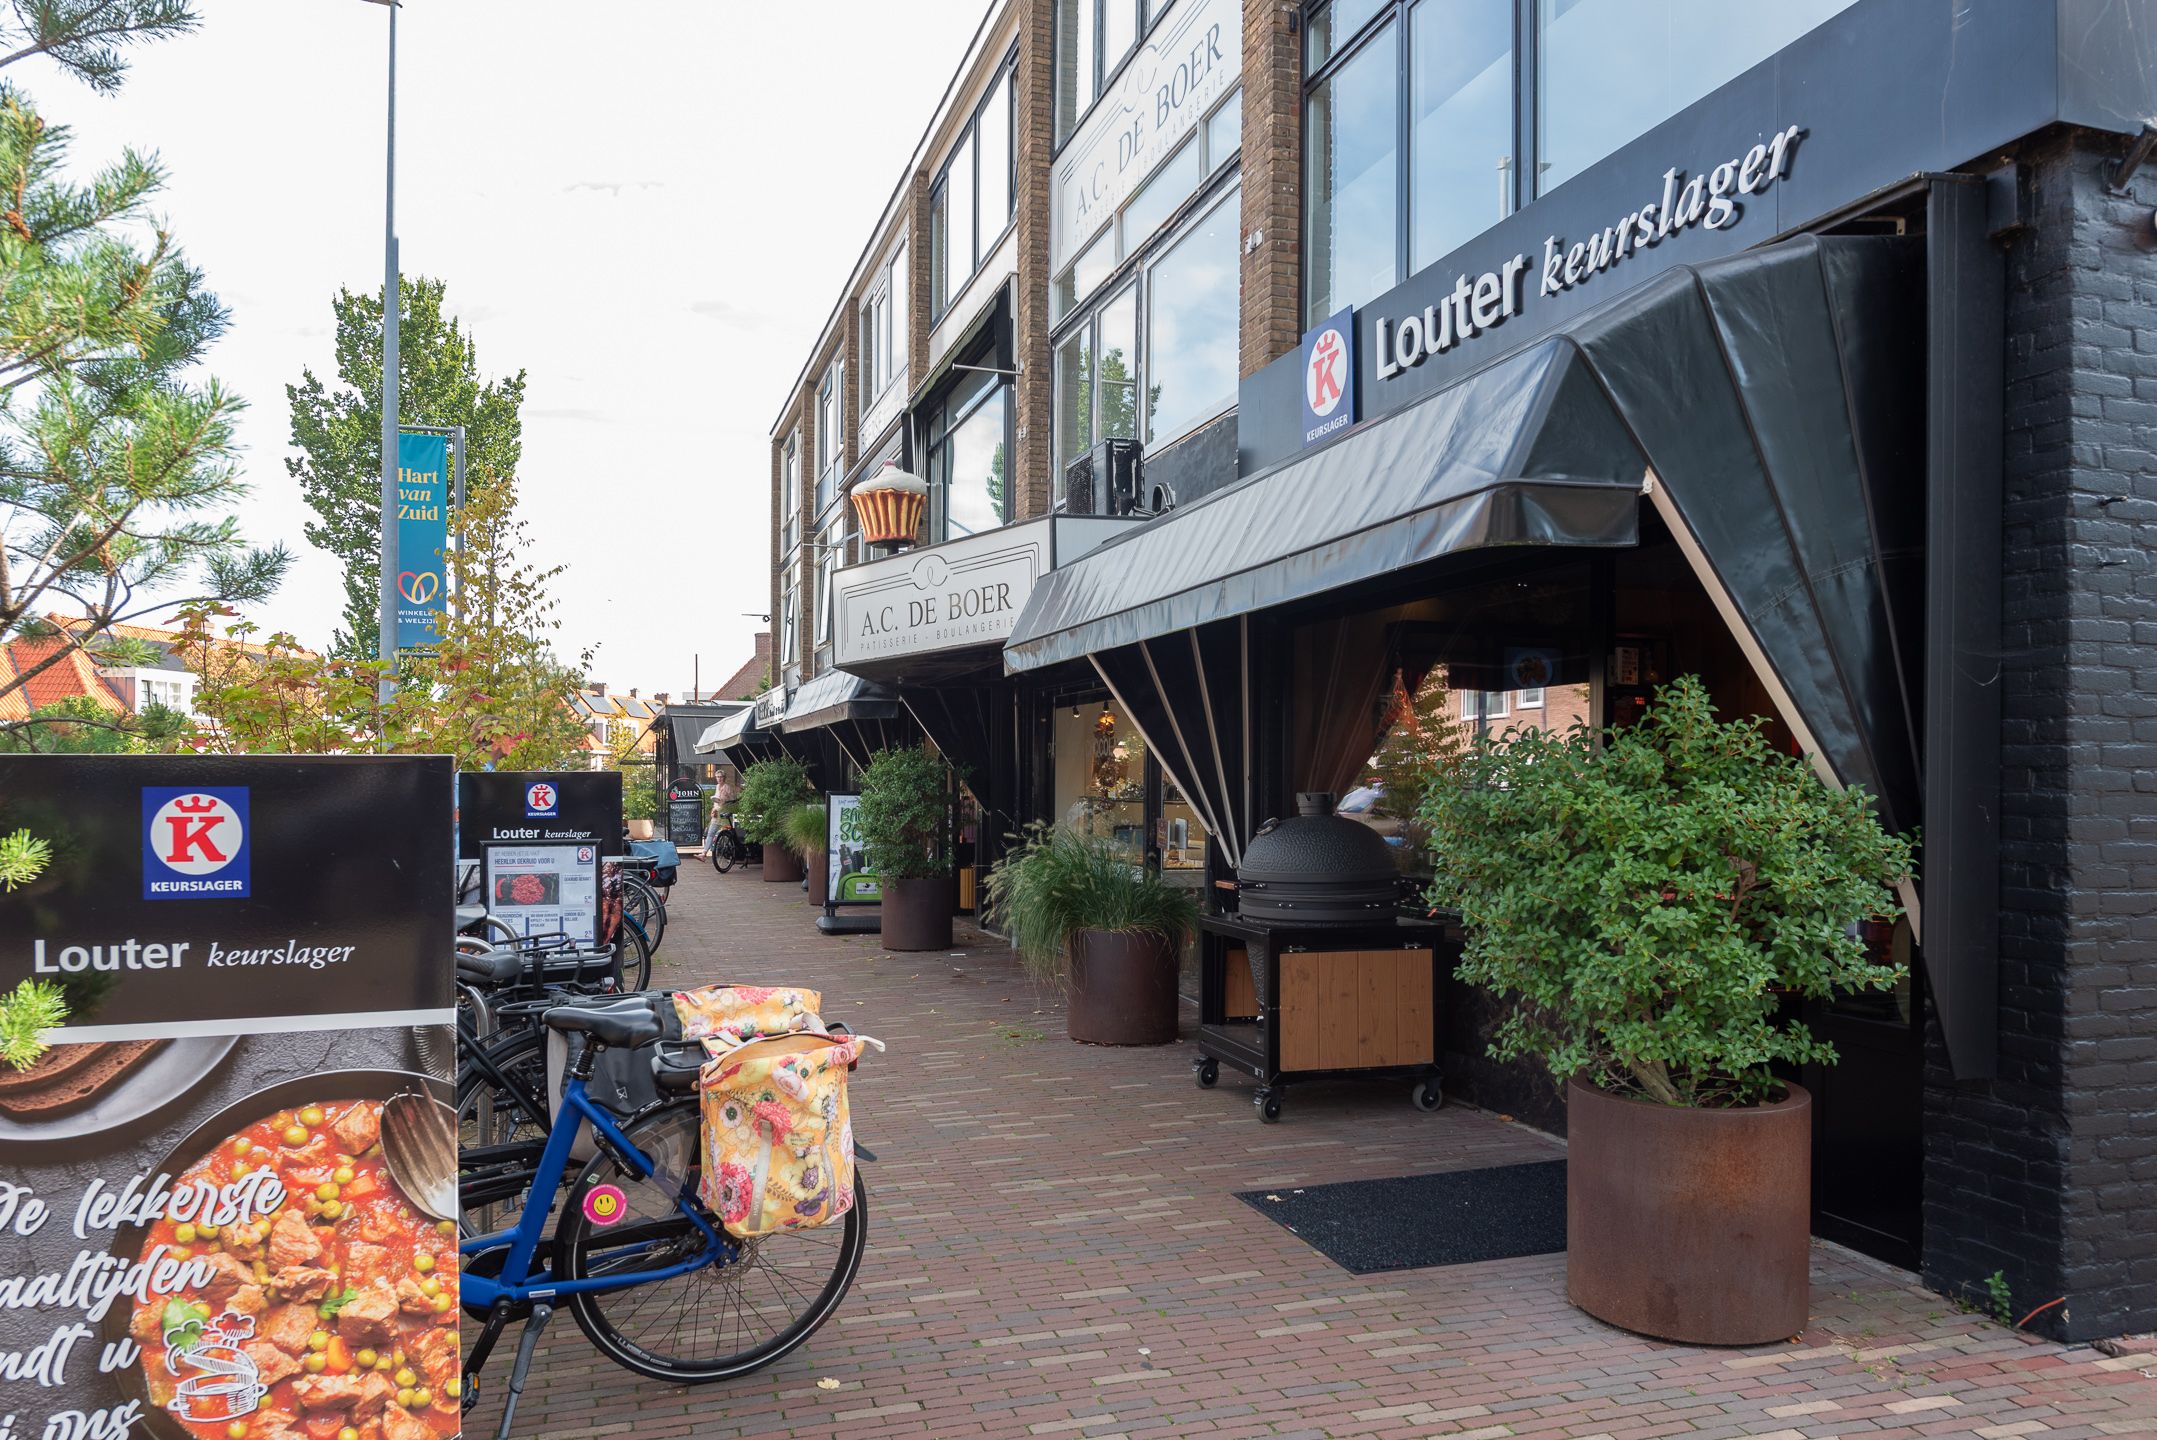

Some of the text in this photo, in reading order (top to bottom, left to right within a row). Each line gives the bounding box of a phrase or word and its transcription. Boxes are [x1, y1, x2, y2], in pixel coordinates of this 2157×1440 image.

[1118, 111, 1145, 175] DE
[1156, 23, 1224, 132] BOER
[1375, 124, 1799, 381] Louter keurslager
[1306, 413, 1348, 443] KEURSLAGER
[398, 467, 439, 484] Hart
[398, 489, 431, 501] van
[398, 504, 439, 521] Zuid
[861, 582, 1013, 637] A.C. DE BOER
[860, 633, 918, 651] PATISSERIE
[936, 616, 1014, 640] BOULANGERIE
[532, 791, 551, 807] K
[165, 816, 227, 863] K
[493, 827, 592, 840] Louter keurslager
[150, 880, 244, 893] KEURSLAGER
[34, 938, 356, 974] Louter keurslager
[73, 1164, 288, 1240] lekkerste
[99, 1337, 142, 1373] u
